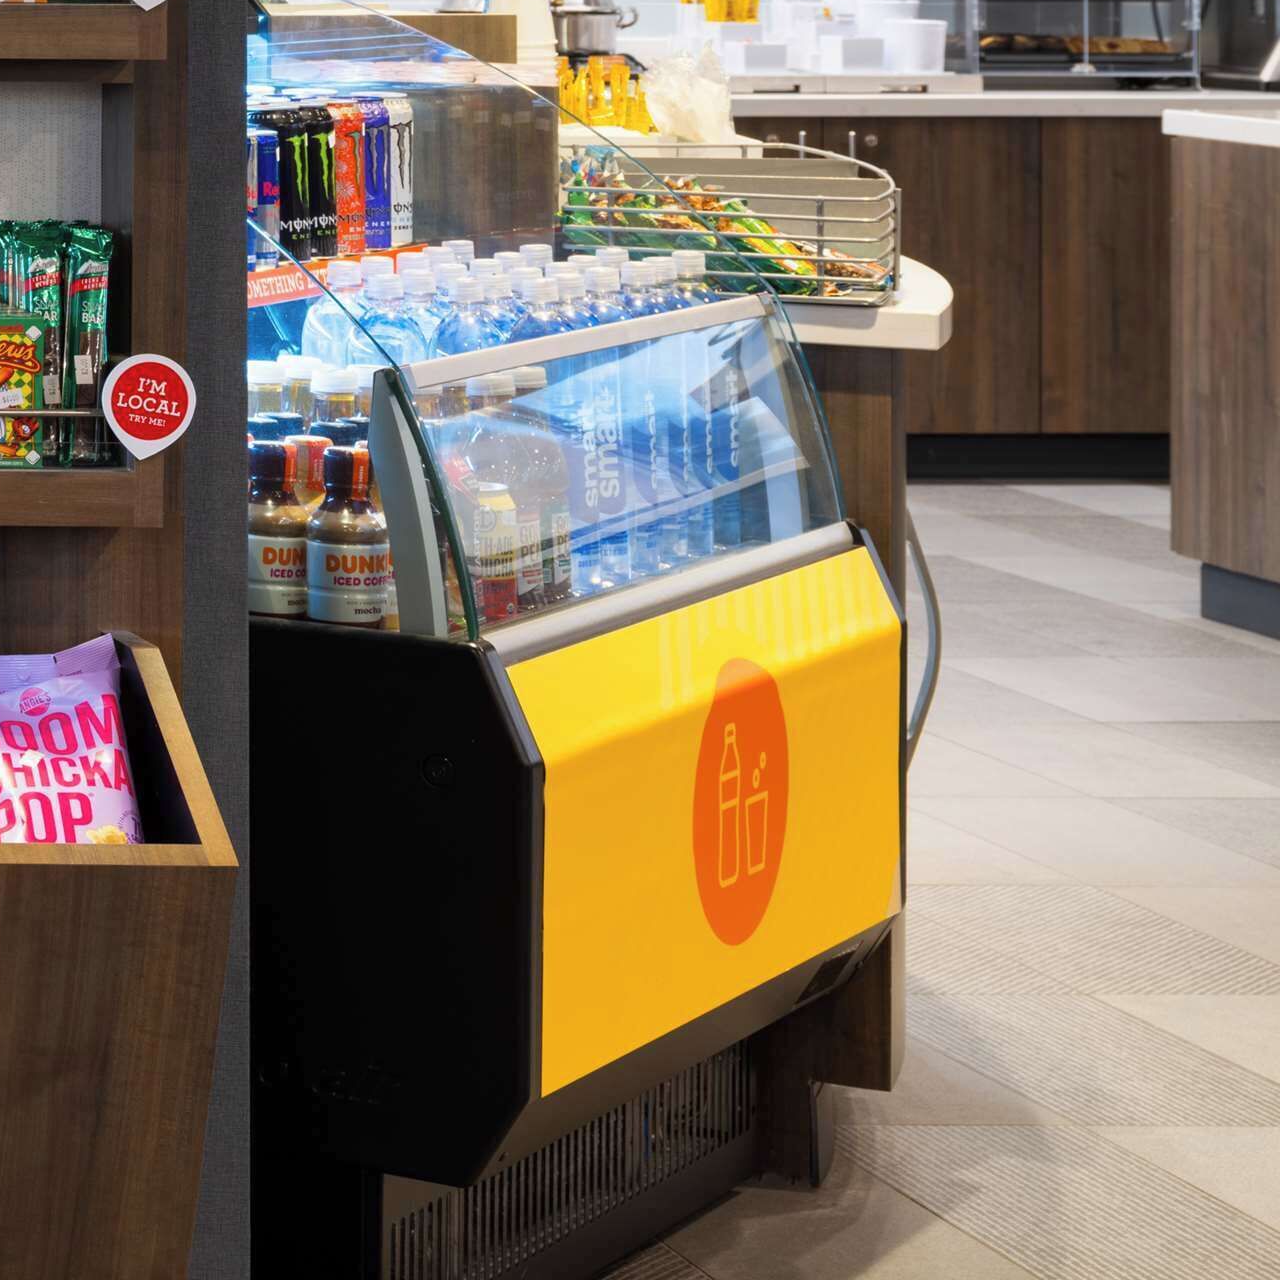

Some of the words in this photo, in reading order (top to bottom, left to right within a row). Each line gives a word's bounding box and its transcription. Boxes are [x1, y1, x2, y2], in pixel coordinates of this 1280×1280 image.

[137, 377, 167, 397] I'M
[117, 393, 182, 418] LOCAL
[128, 413, 149, 427] TRY
[148, 416, 168, 428] ME!
[333, 575, 361, 587] ICED
[354, 605, 382, 616] mocha
